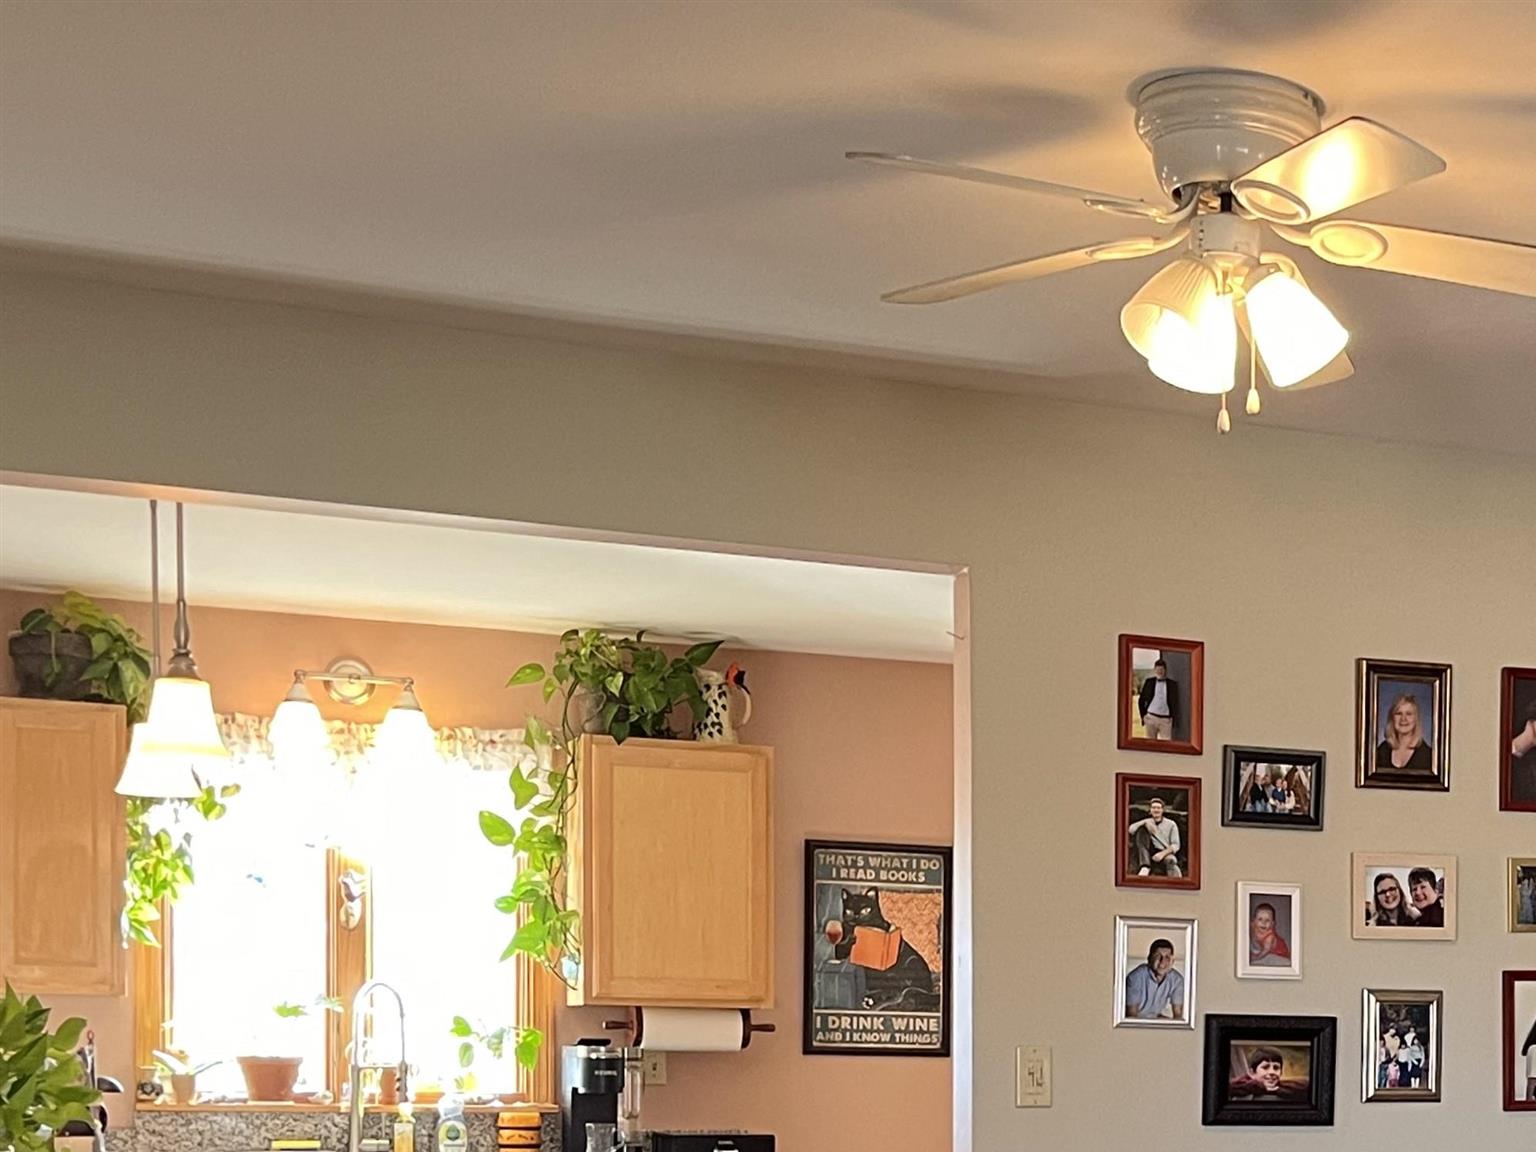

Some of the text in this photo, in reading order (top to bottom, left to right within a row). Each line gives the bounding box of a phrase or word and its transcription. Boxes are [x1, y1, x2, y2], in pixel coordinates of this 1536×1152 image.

[818, 854, 940, 870] THAT'S WHAT I DO
[832, 867, 926, 882] I READ BOOKS
[816, 1015, 939, 1031] I DRINK WINE
[816, 1031, 938, 1043] AND I KNOW THINGS
